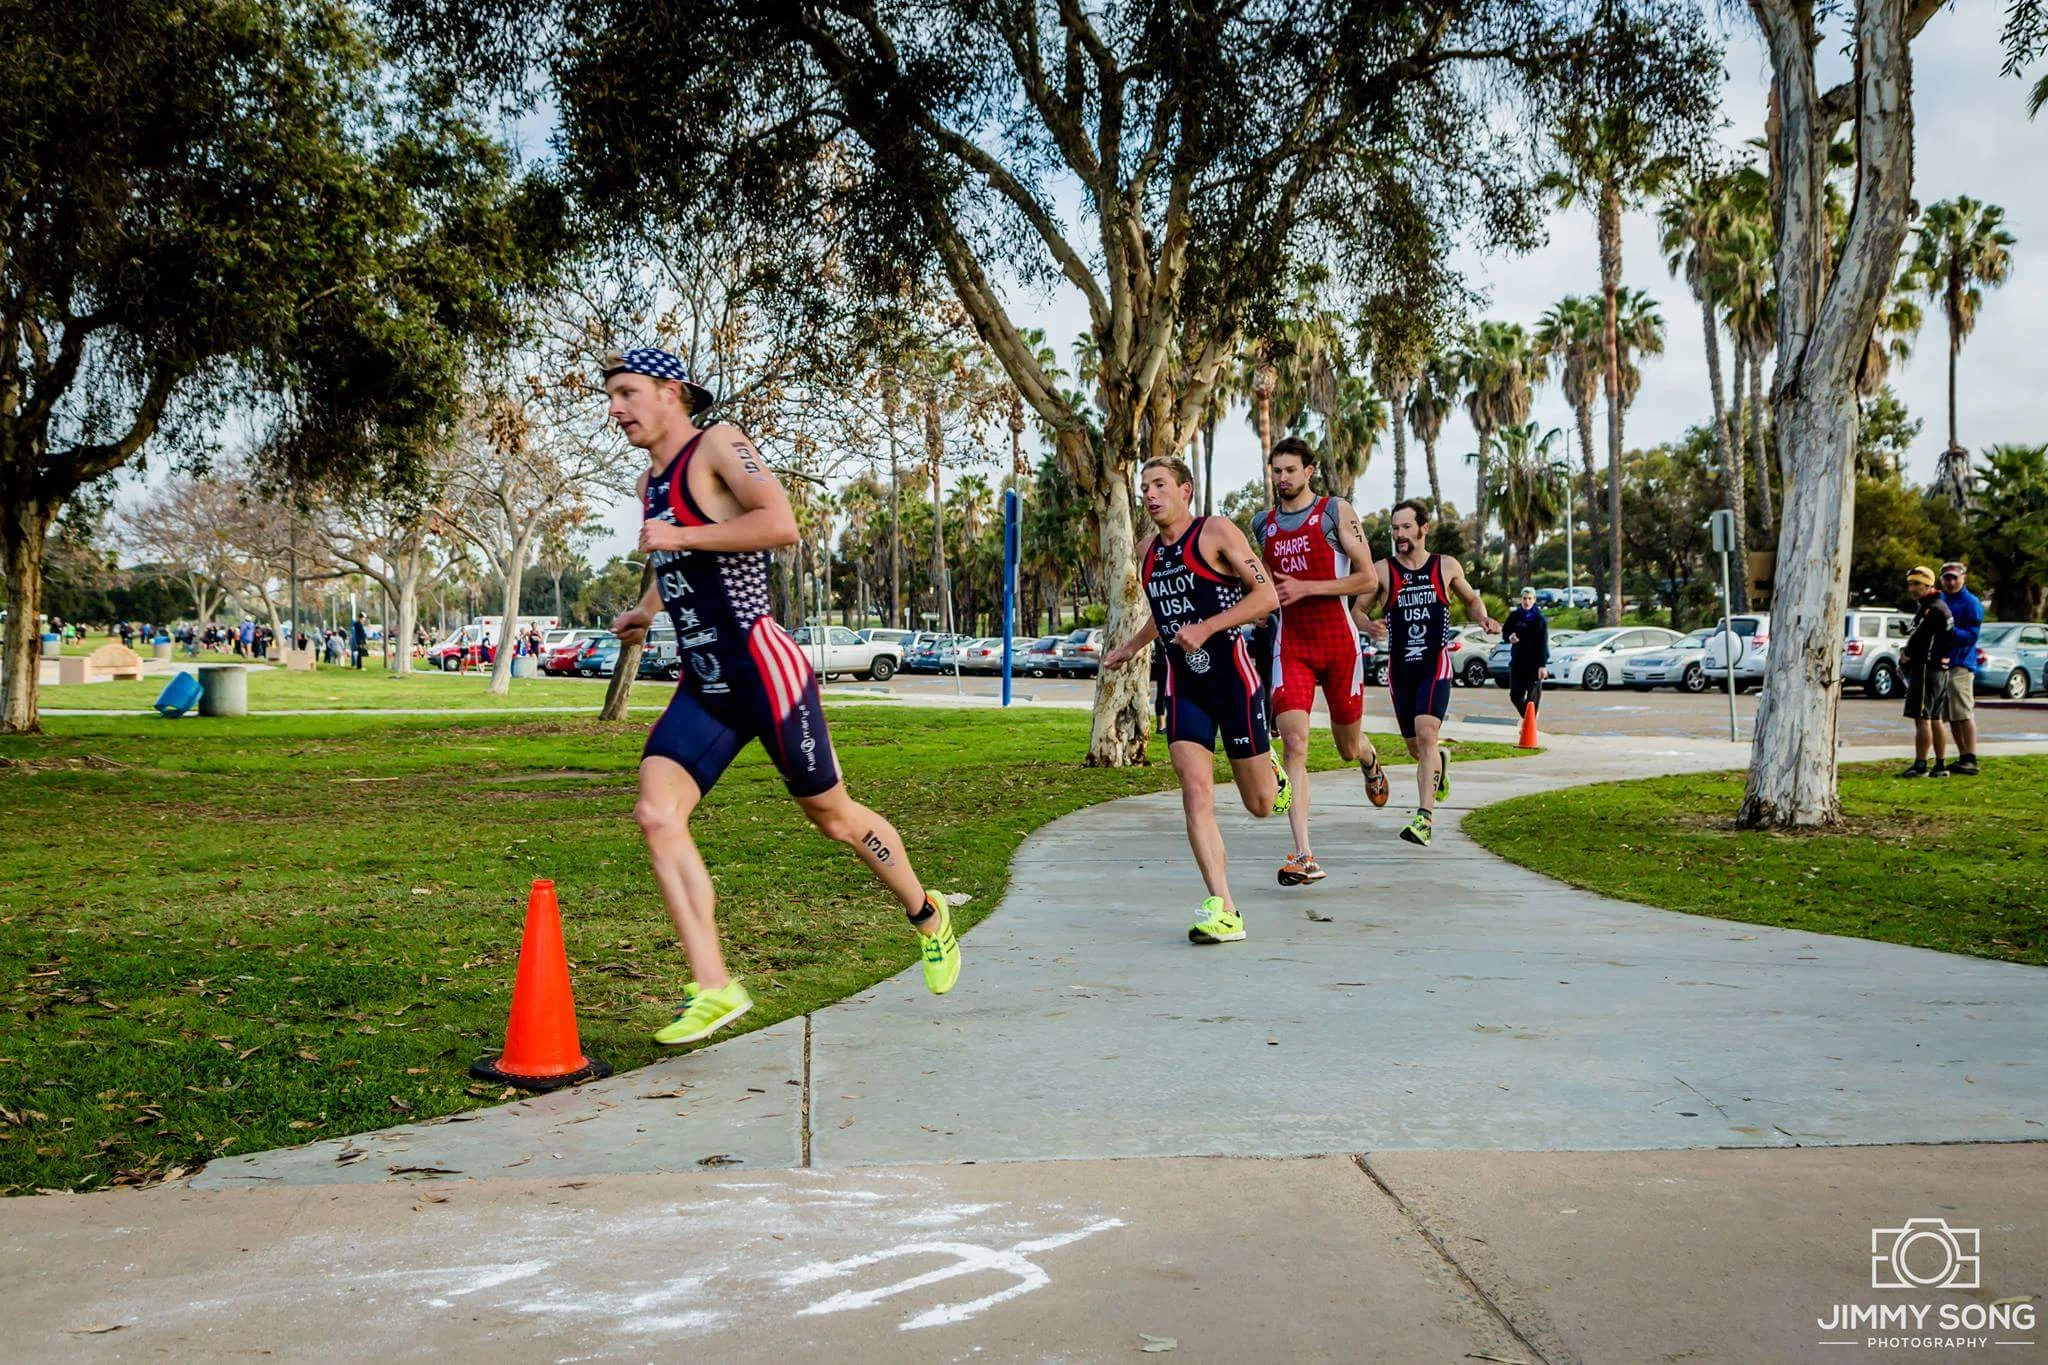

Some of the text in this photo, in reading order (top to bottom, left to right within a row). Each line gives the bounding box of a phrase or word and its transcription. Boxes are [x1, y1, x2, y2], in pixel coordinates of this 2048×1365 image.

[1273, 535, 1311, 557] SHARPE
[1281, 555, 1308, 573] CAN
[1148, 572, 1196, 598] MALOY
[1160, 596, 1196, 617] USA
[1397, 591, 1438, 608] BILLINGTON
[1404, 607, 1431, 622] USA
[1233, 737, 1250, 745] TYR
